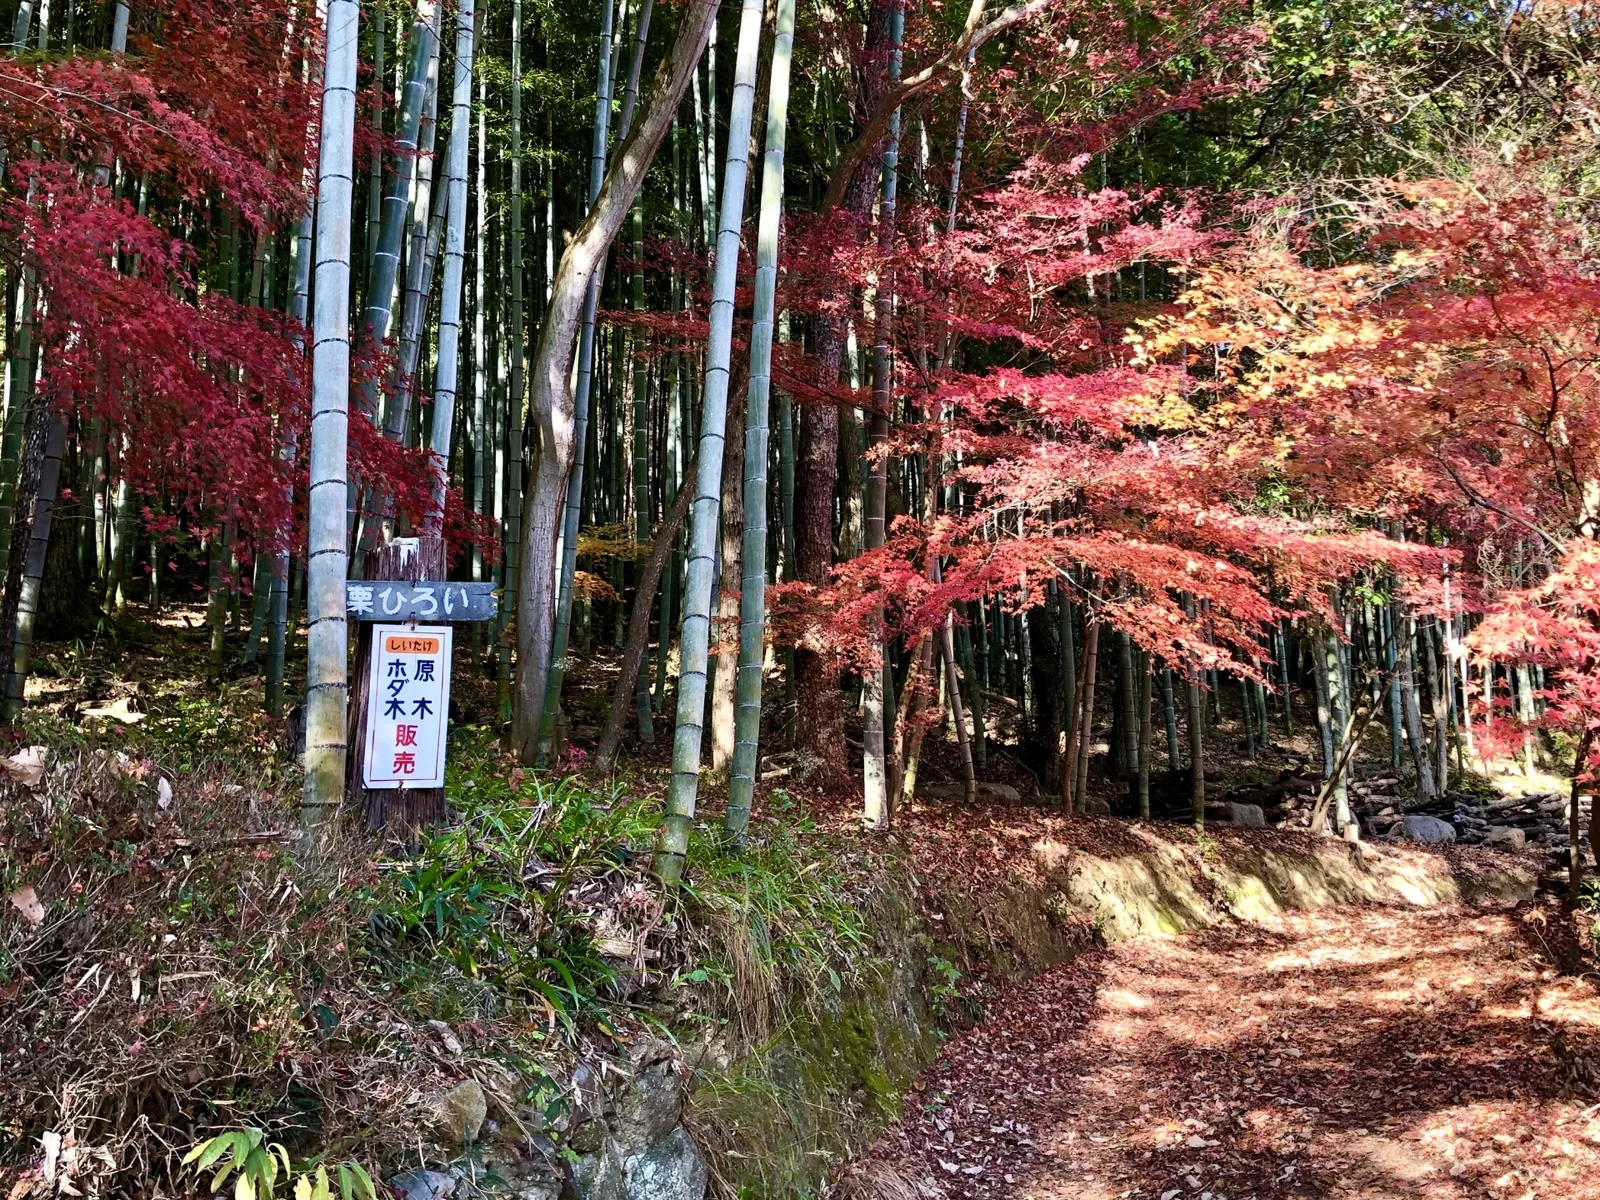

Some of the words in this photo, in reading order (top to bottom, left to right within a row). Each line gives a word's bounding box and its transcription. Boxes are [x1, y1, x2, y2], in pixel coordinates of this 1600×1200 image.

[347, 585, 469, 615] 栗ひろい
[391, 639, 433, 652] しいたけ
[384, 658, 410, 720] ホダ木
[411, 659, 435, 720] 原木
[392, 724, 418, 774] 販売
